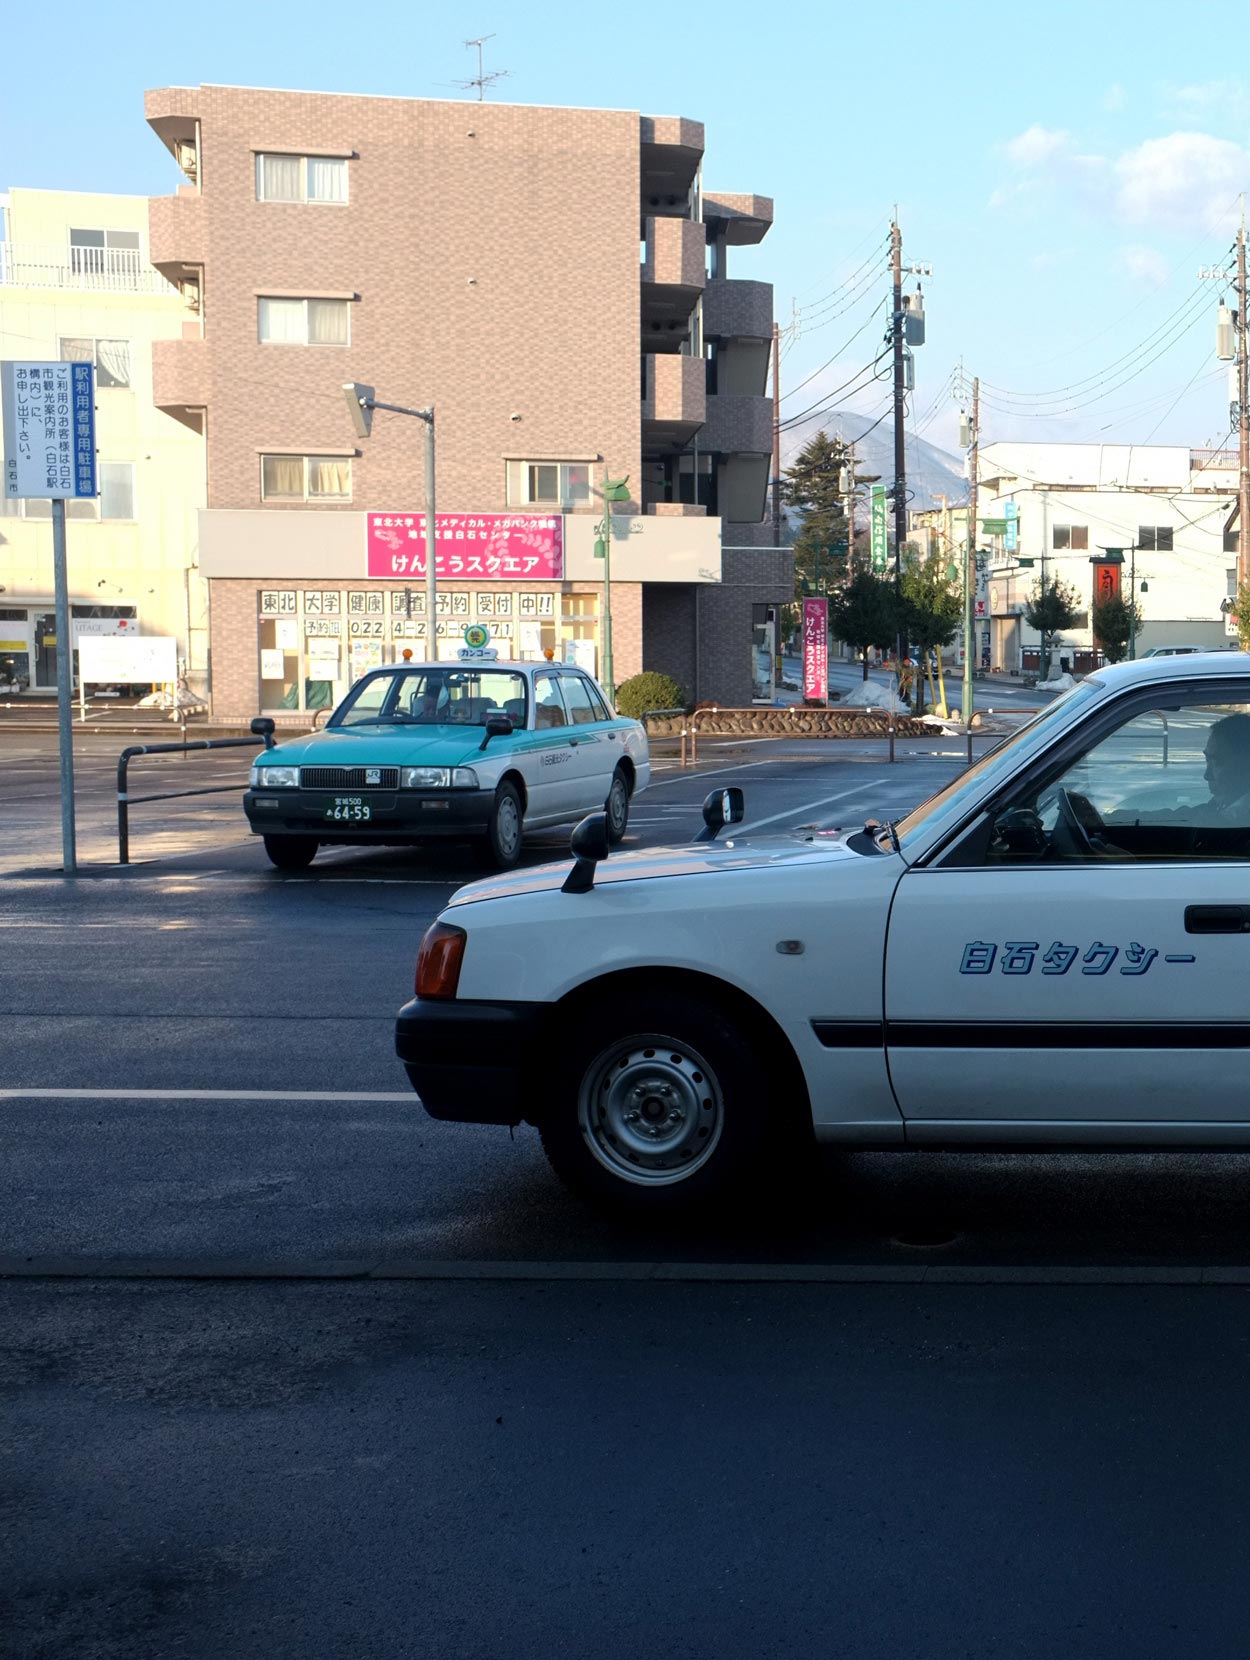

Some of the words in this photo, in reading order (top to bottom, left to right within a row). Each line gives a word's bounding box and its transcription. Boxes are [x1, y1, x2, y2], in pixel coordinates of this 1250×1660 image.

[16, 368, 31, 460] お申し出下さい。
[57, 368, 71, 489] ご利用のお客様は白石
[75, 367, 92, 493] 駅利用者専用駐車場
[9, 459, 18, 492] 白石市
[373, 518, 414, 527] 東北大学
[391, 554, 539, 573] けんこうスクエア
[351, 621, 510, 635] 0224-26-971
[806, 618, 815, 693] けんこうスクエア
[334, 806, 370, 819] 64-59
[959, 941, 1196, 975] 白石タクシー
